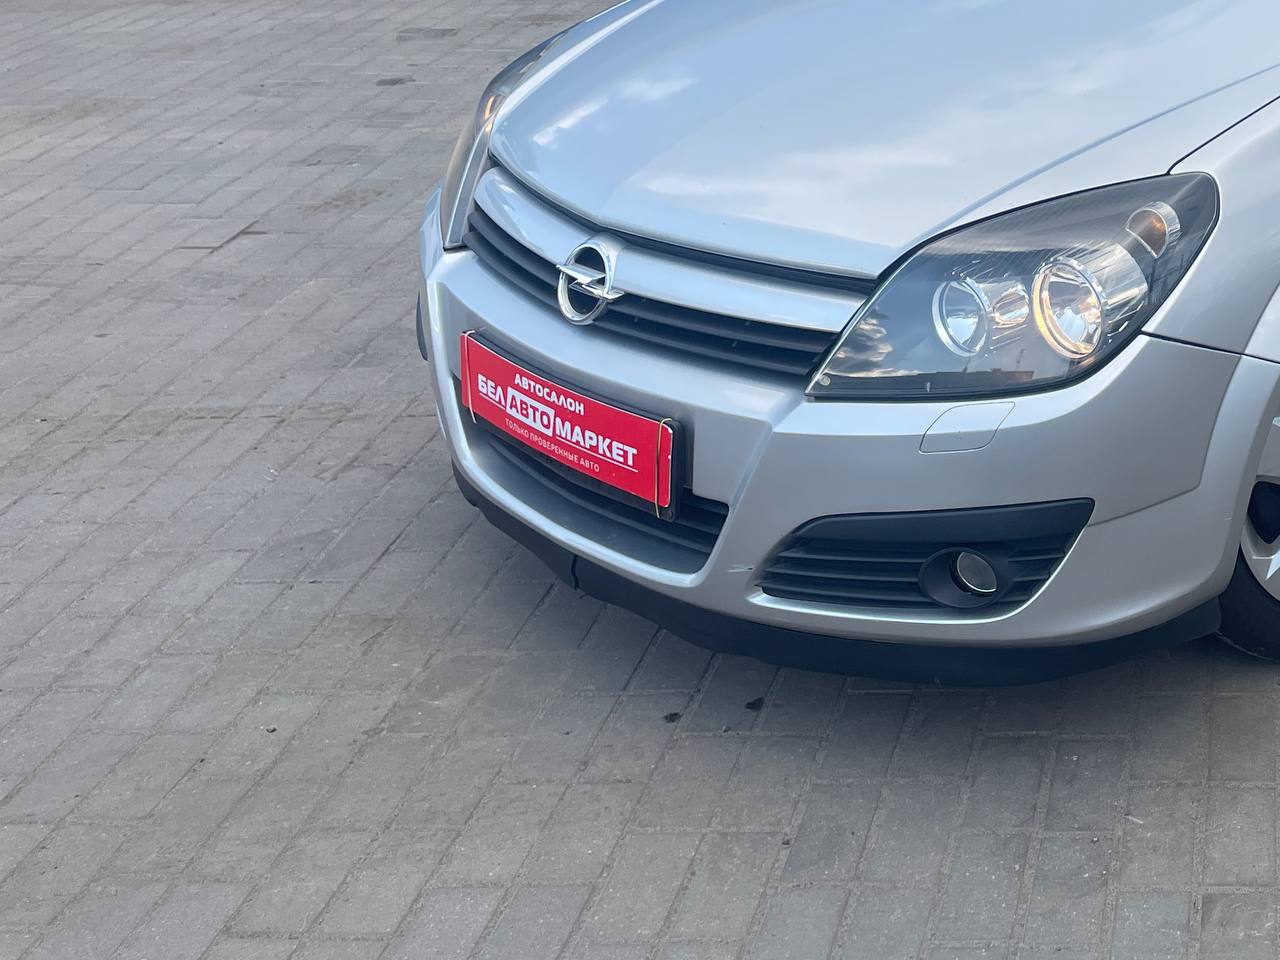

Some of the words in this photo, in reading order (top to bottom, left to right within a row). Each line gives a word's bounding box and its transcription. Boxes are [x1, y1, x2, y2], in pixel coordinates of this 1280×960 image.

[477, 373, 506, 407] БЕЛ
[508, 392, 552, 431] АВТО
[555, 416, 638, 467] МАРКЕТ
[514, 373, 585, 416] АВТОСАЛОН
[504, 417, 530, 439] ТОЛЬКО
[529, 431, 579, 464] ПРОВЕРЕННЫЕ
[579, 458, 600, 472] АВТО
